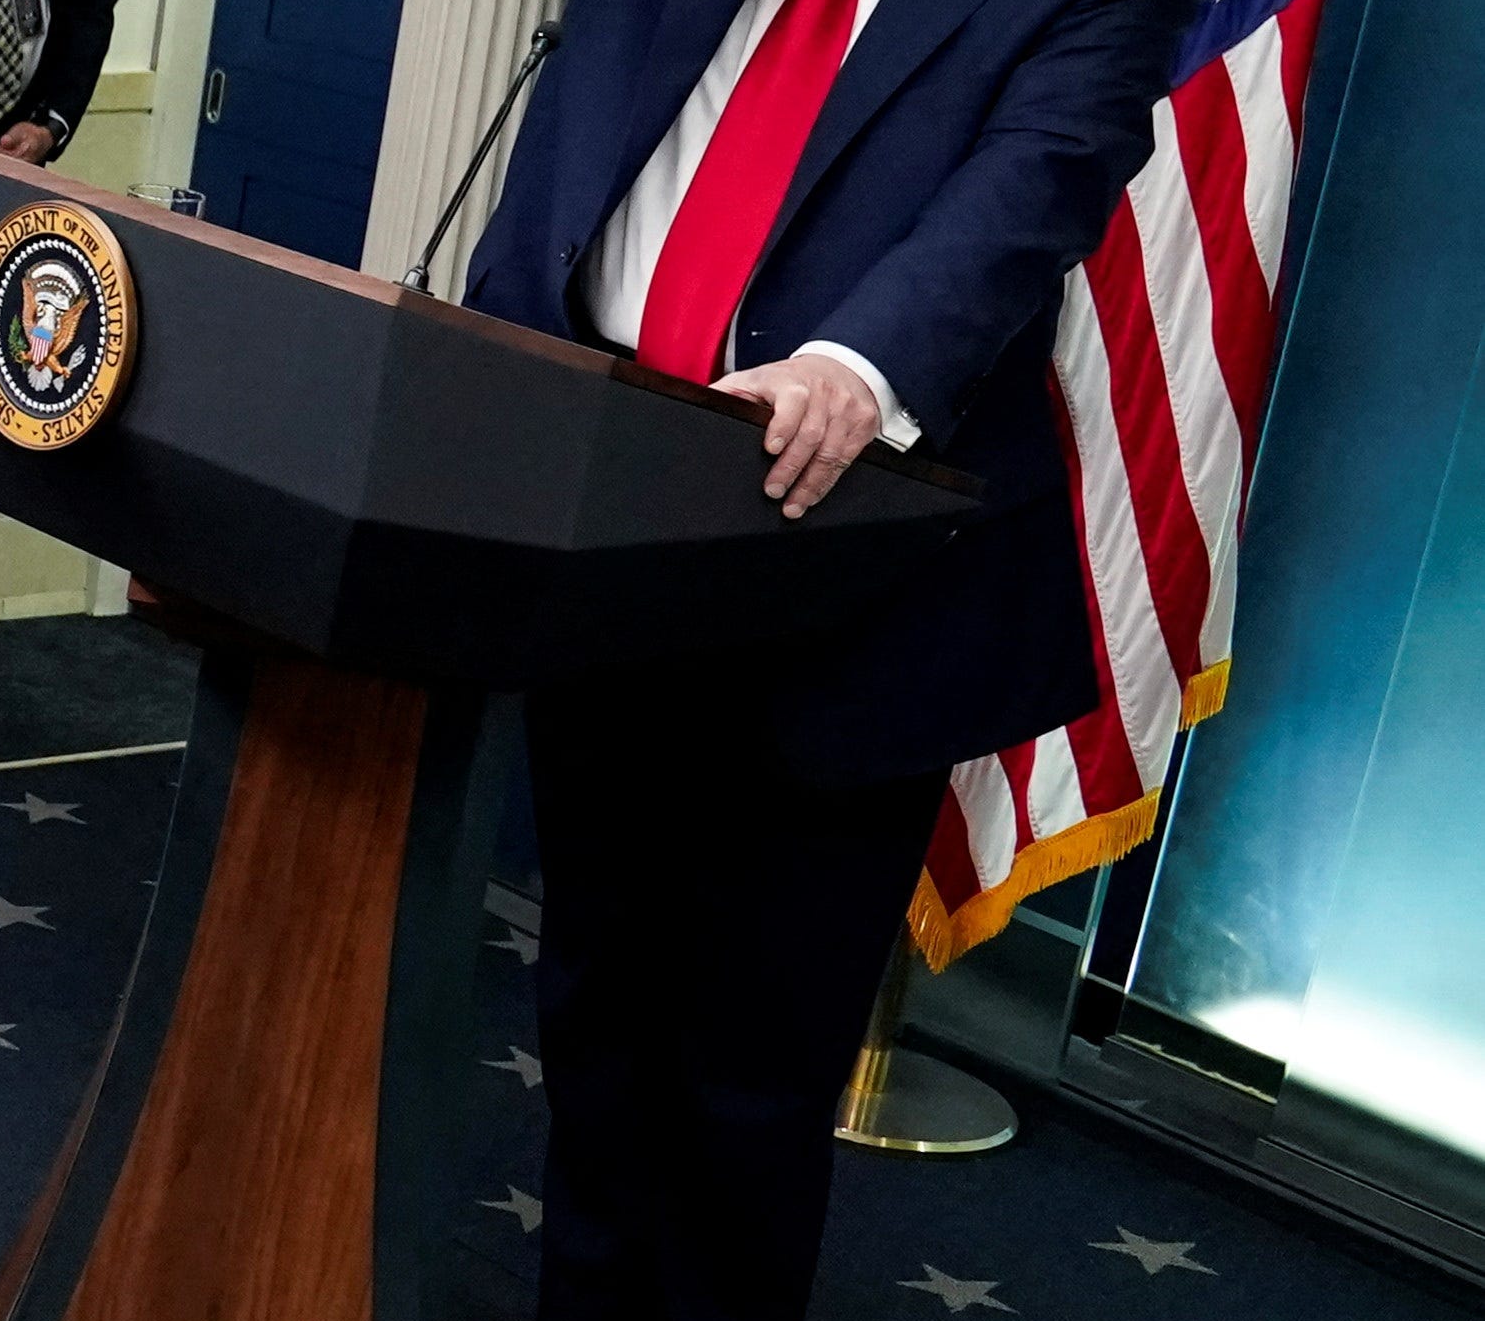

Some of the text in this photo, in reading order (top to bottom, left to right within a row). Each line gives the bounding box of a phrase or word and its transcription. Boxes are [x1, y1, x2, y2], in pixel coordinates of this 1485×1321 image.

[63, 216, 80, 235] OF
[77, 227, 101, 257] THE
[99, 258, 124, 368] UNITED
[41, 386, 105, 444] STATES
